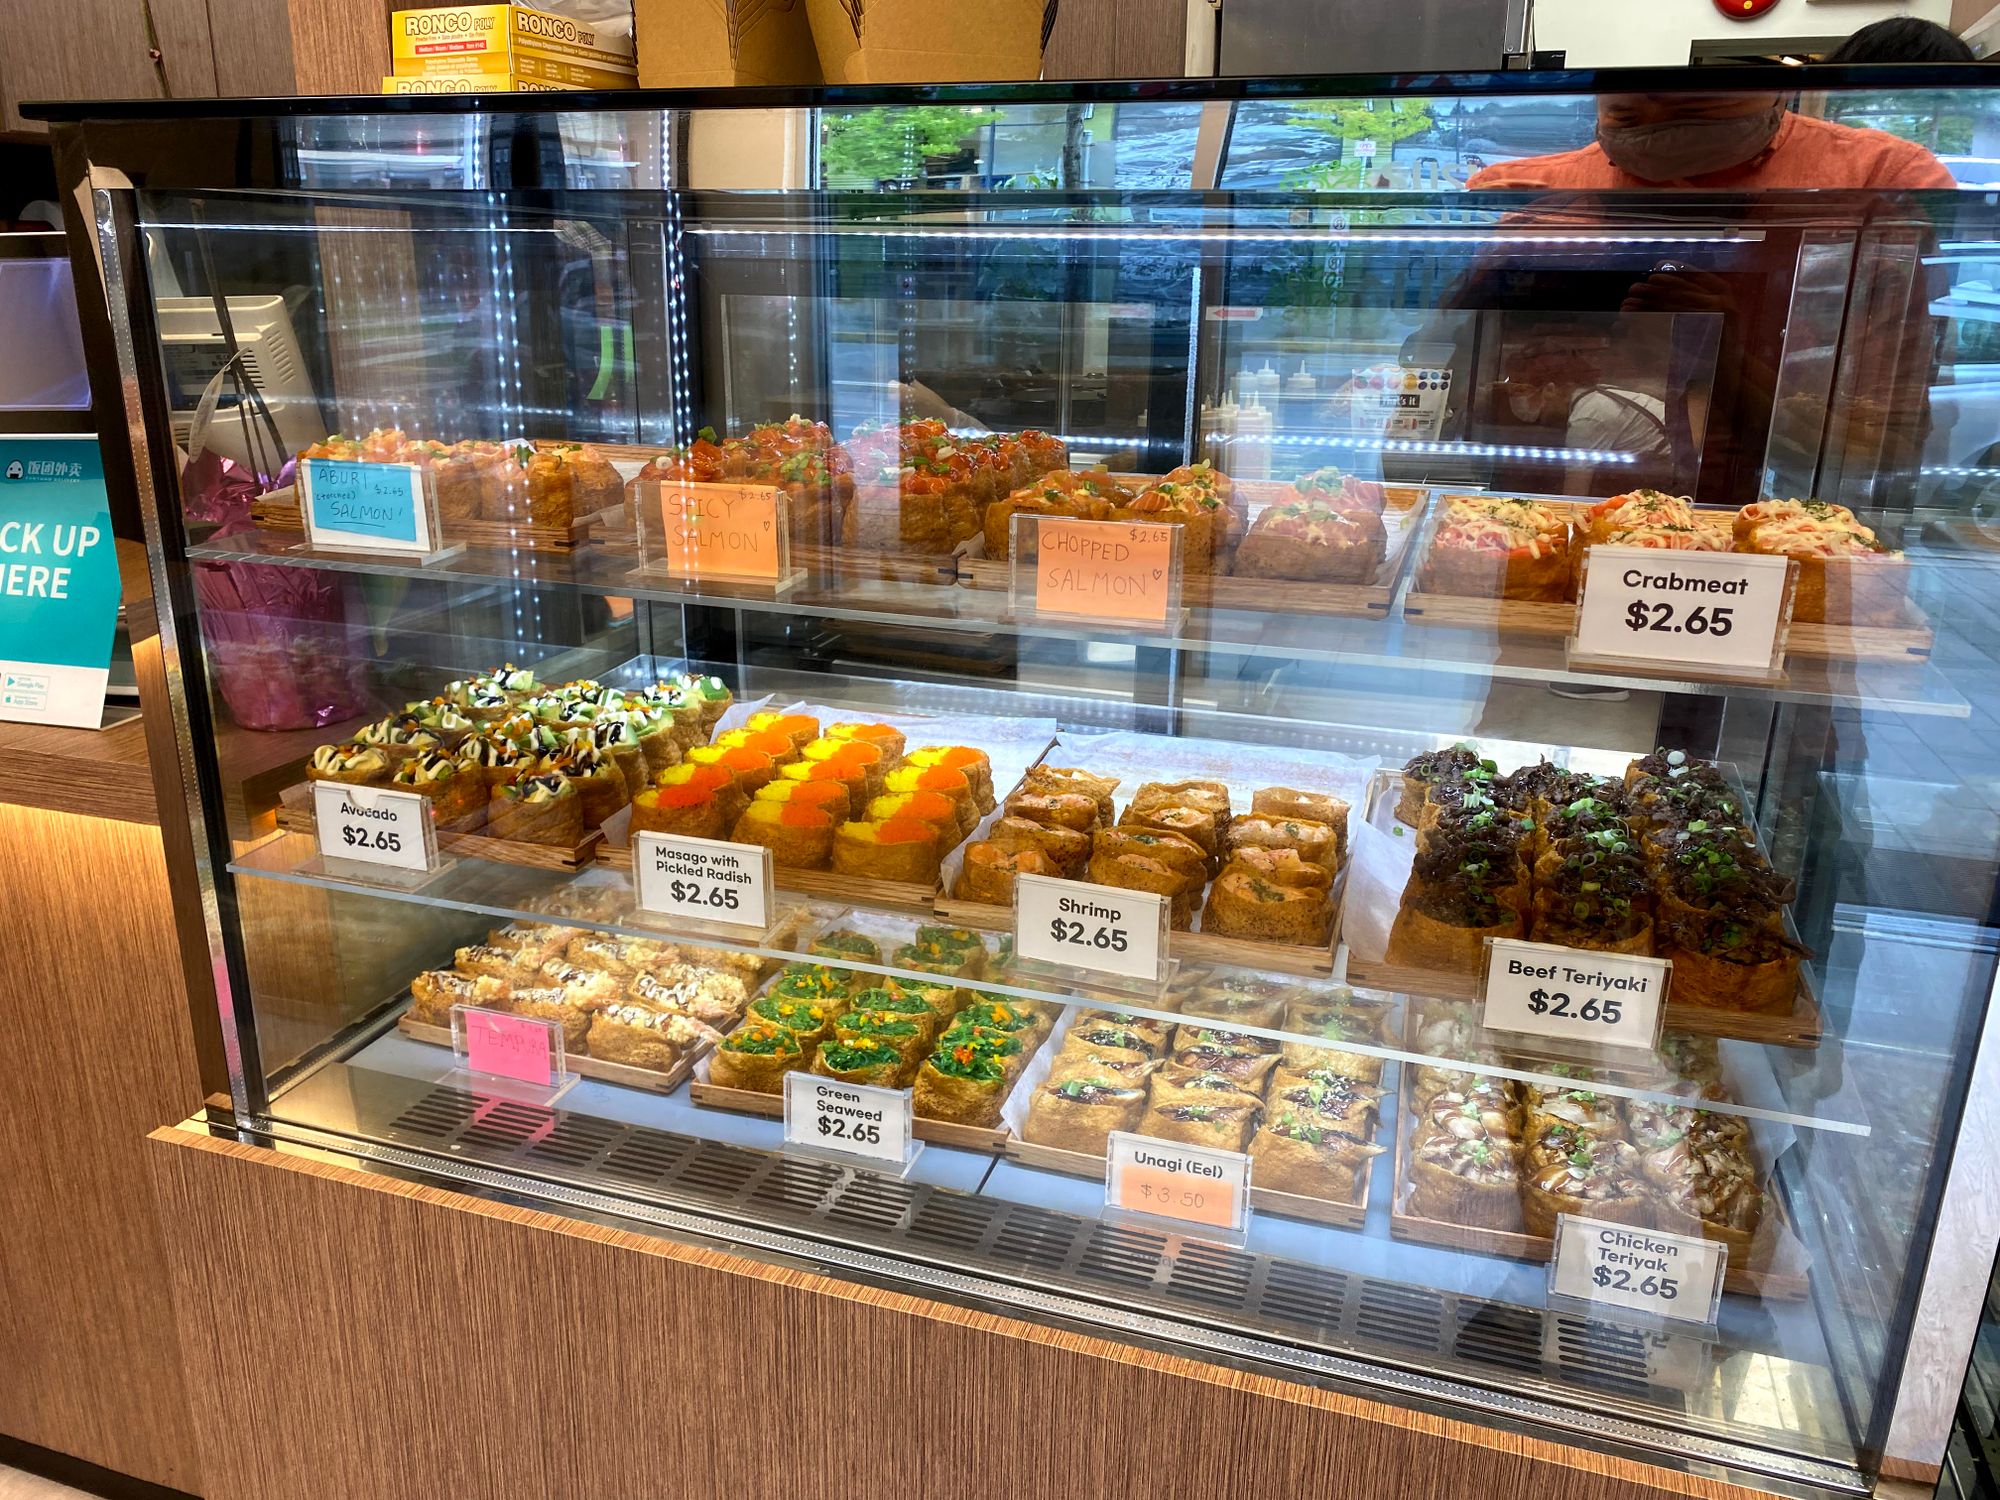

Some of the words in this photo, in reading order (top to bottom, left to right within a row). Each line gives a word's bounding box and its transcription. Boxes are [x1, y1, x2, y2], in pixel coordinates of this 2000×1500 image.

[405, 12, 472, 36] RONCO
[474, 17, 495, 31] POLY
[516, 11, 576, 41] RONCO
[577, 31, 595, 46] POLY
[397, 79, 471, 94] RONCO
[319, 468, 367, 489] ABURI
[375, 484, 404, 497] $2.65
[669, 493, 735, 518] SPICY
[739, 487, 771, 501] $2.65
[53, 524, 100, 558] UP
[672, 523, 758, 552] SALMON
[1041, 531, 1129, 562] CHOPPED
[1129, 528, 1168, 544] $2.65
[0, 563, 71, 599] ERE
[1046, 566, 1146, 596] SALMON
[1623, 569, 1749, 595] Crabmeat
[1624, 599, 1734, 637] $2.65
[340, 802, 398, 822] Avocado
[342, 824, 402, 852] $2.65
[655, 846, 707, 866] Masago
[711, 854, 739, 868] with
[656, 860, 703, 877] Pickled
[706, 868, 752, 884] Radish
[671, 879, 739, 910] $2.65
[1058, 897, 1122, 924] Shrimp
[1050, 917, 1128, 952] $2.65
[1508, 959, 1557, 980] Beef
[1562, 967, 1648, 993] Teriyaki
[1527, 987, 1622, 1024] $2.65
[816, 1085, 860, 1103] Green
[816, 1099, 883, 1122] Seaweed
[818, 1115, 881, 1145] $2.65
[1134, 1151, 1182, 1173] Unagi
[1186, 1160, 1223, 1179] (Eel)
[1600, 1230, 1679, 1257] Chicken
[1598, 1247, 1668, 1272] Teriyak
[1592, 1264, 1679, 1300] $2.65
